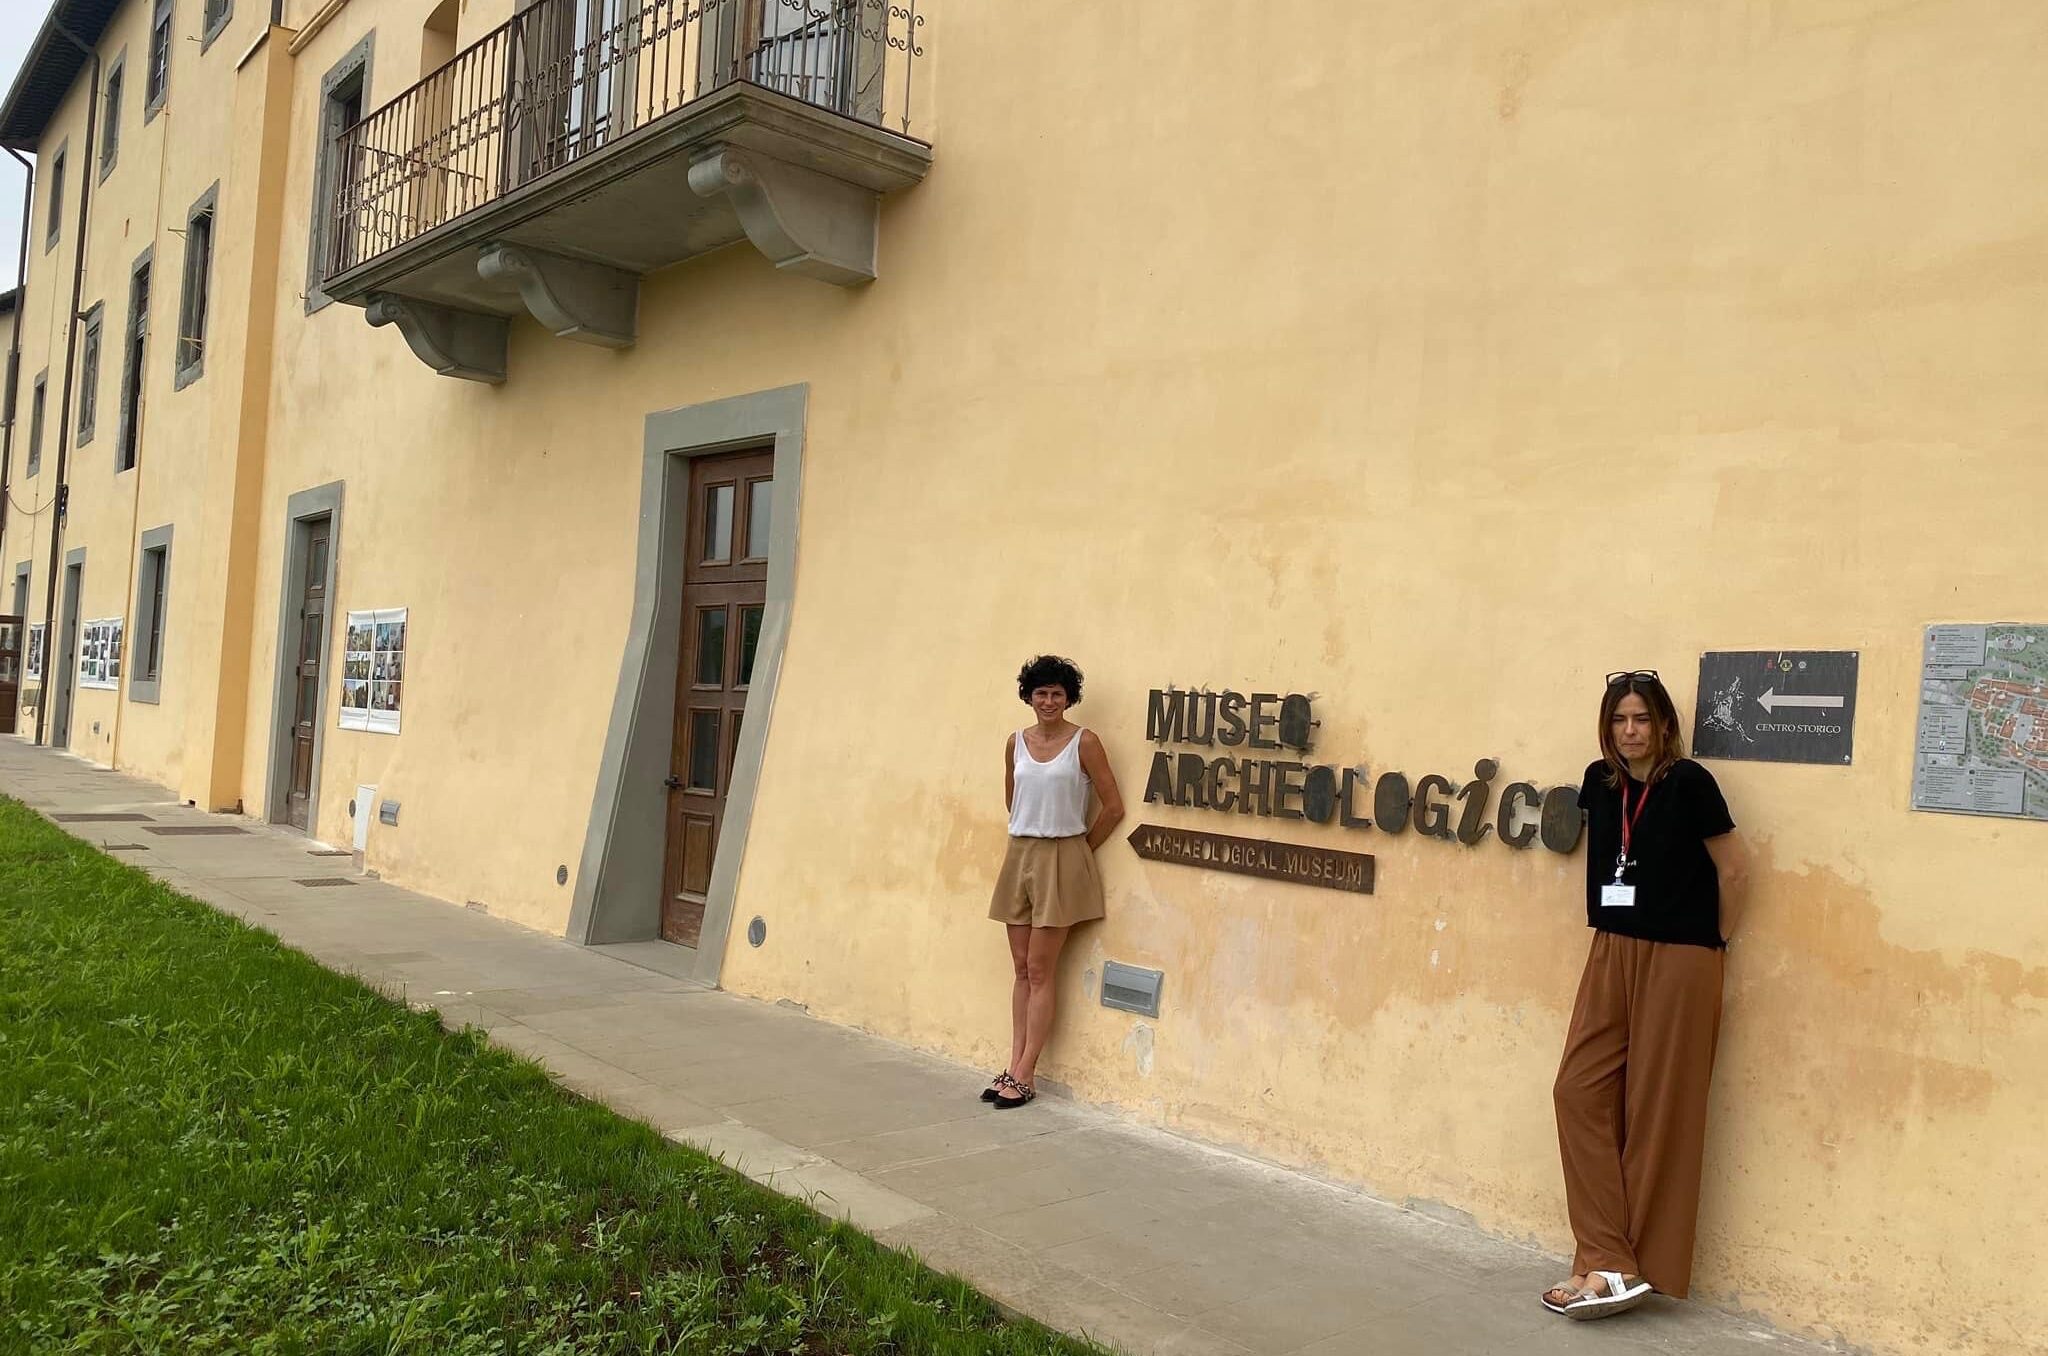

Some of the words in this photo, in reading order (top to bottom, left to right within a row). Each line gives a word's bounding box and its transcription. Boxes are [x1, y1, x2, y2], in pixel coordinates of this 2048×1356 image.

[1146, 689, 1312, 750] MUSEO
[1755, 723, 1796, 732] CENTRO
[1797, 724, 1841, 734] STORICO
[1143, 832, 1277, 871] ARCHAEOLOGICAL
[1283, 851, 1363, 885] MUSEUM
